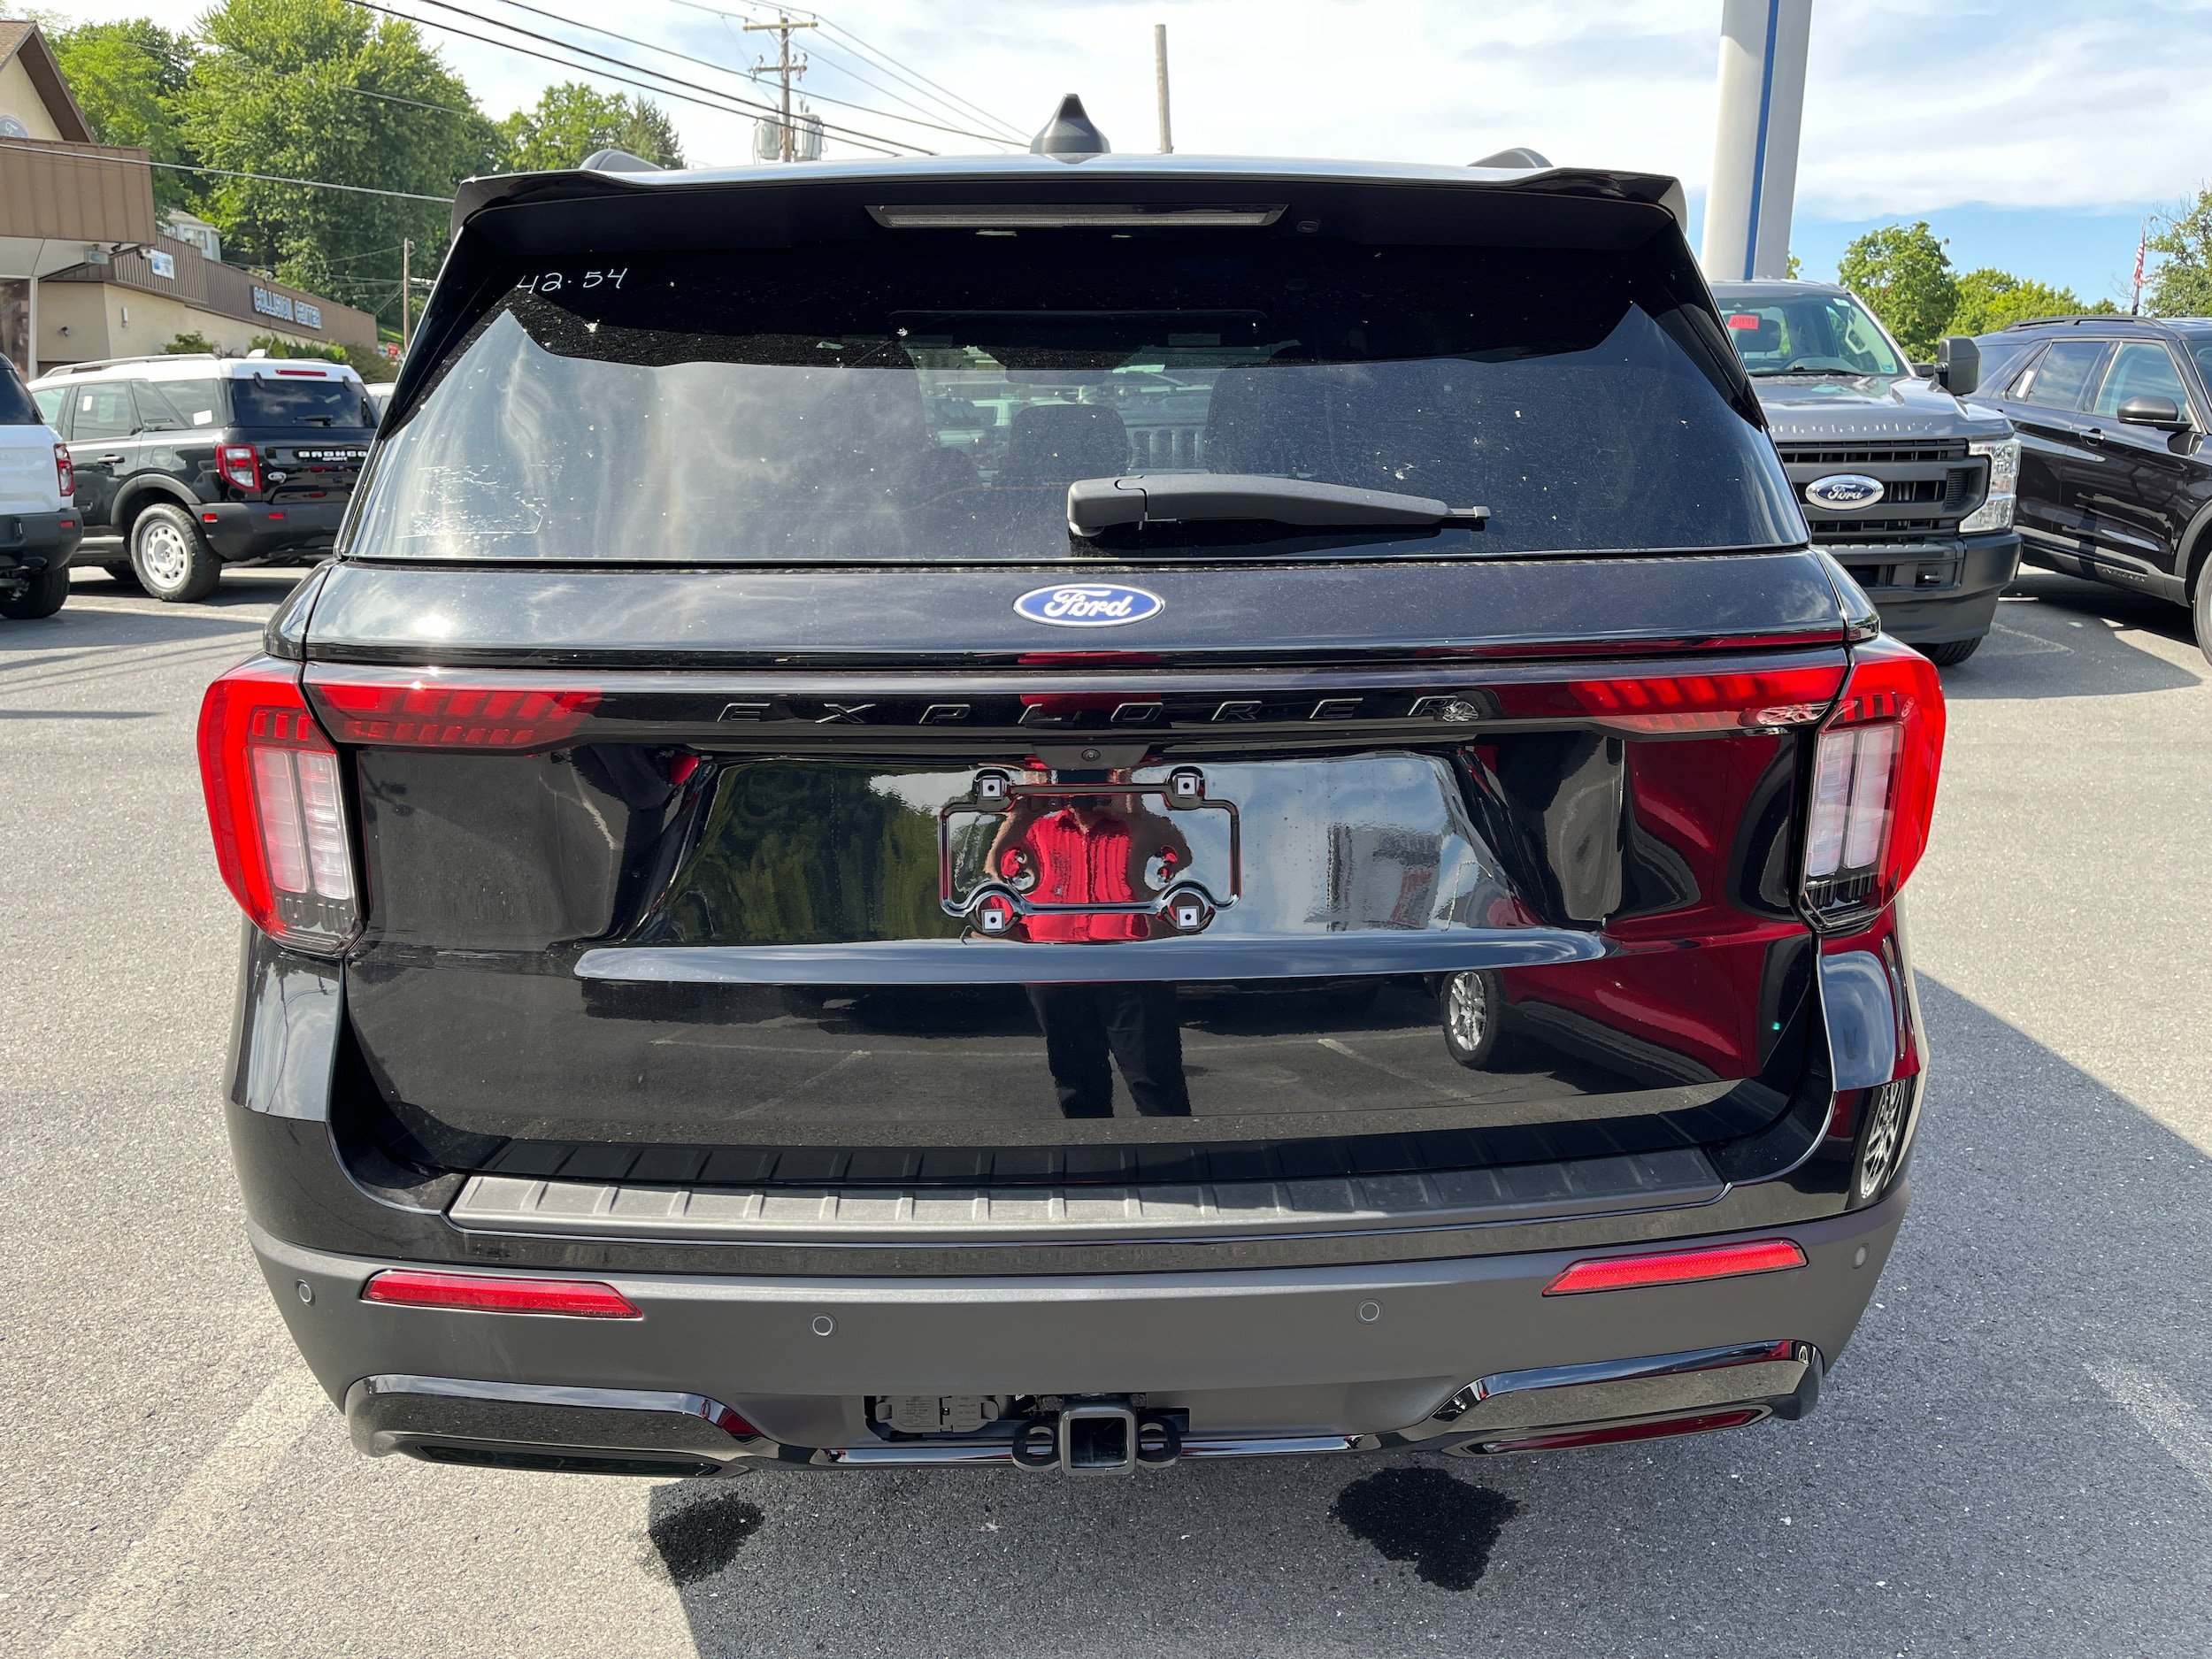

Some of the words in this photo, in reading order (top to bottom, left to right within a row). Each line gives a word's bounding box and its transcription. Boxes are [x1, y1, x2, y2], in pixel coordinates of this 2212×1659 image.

[1827, 483, 1864, 500] Ford
[1044, 588, 1133, 617] Ford
[717, 694, 1458, 724] EXPLORER
